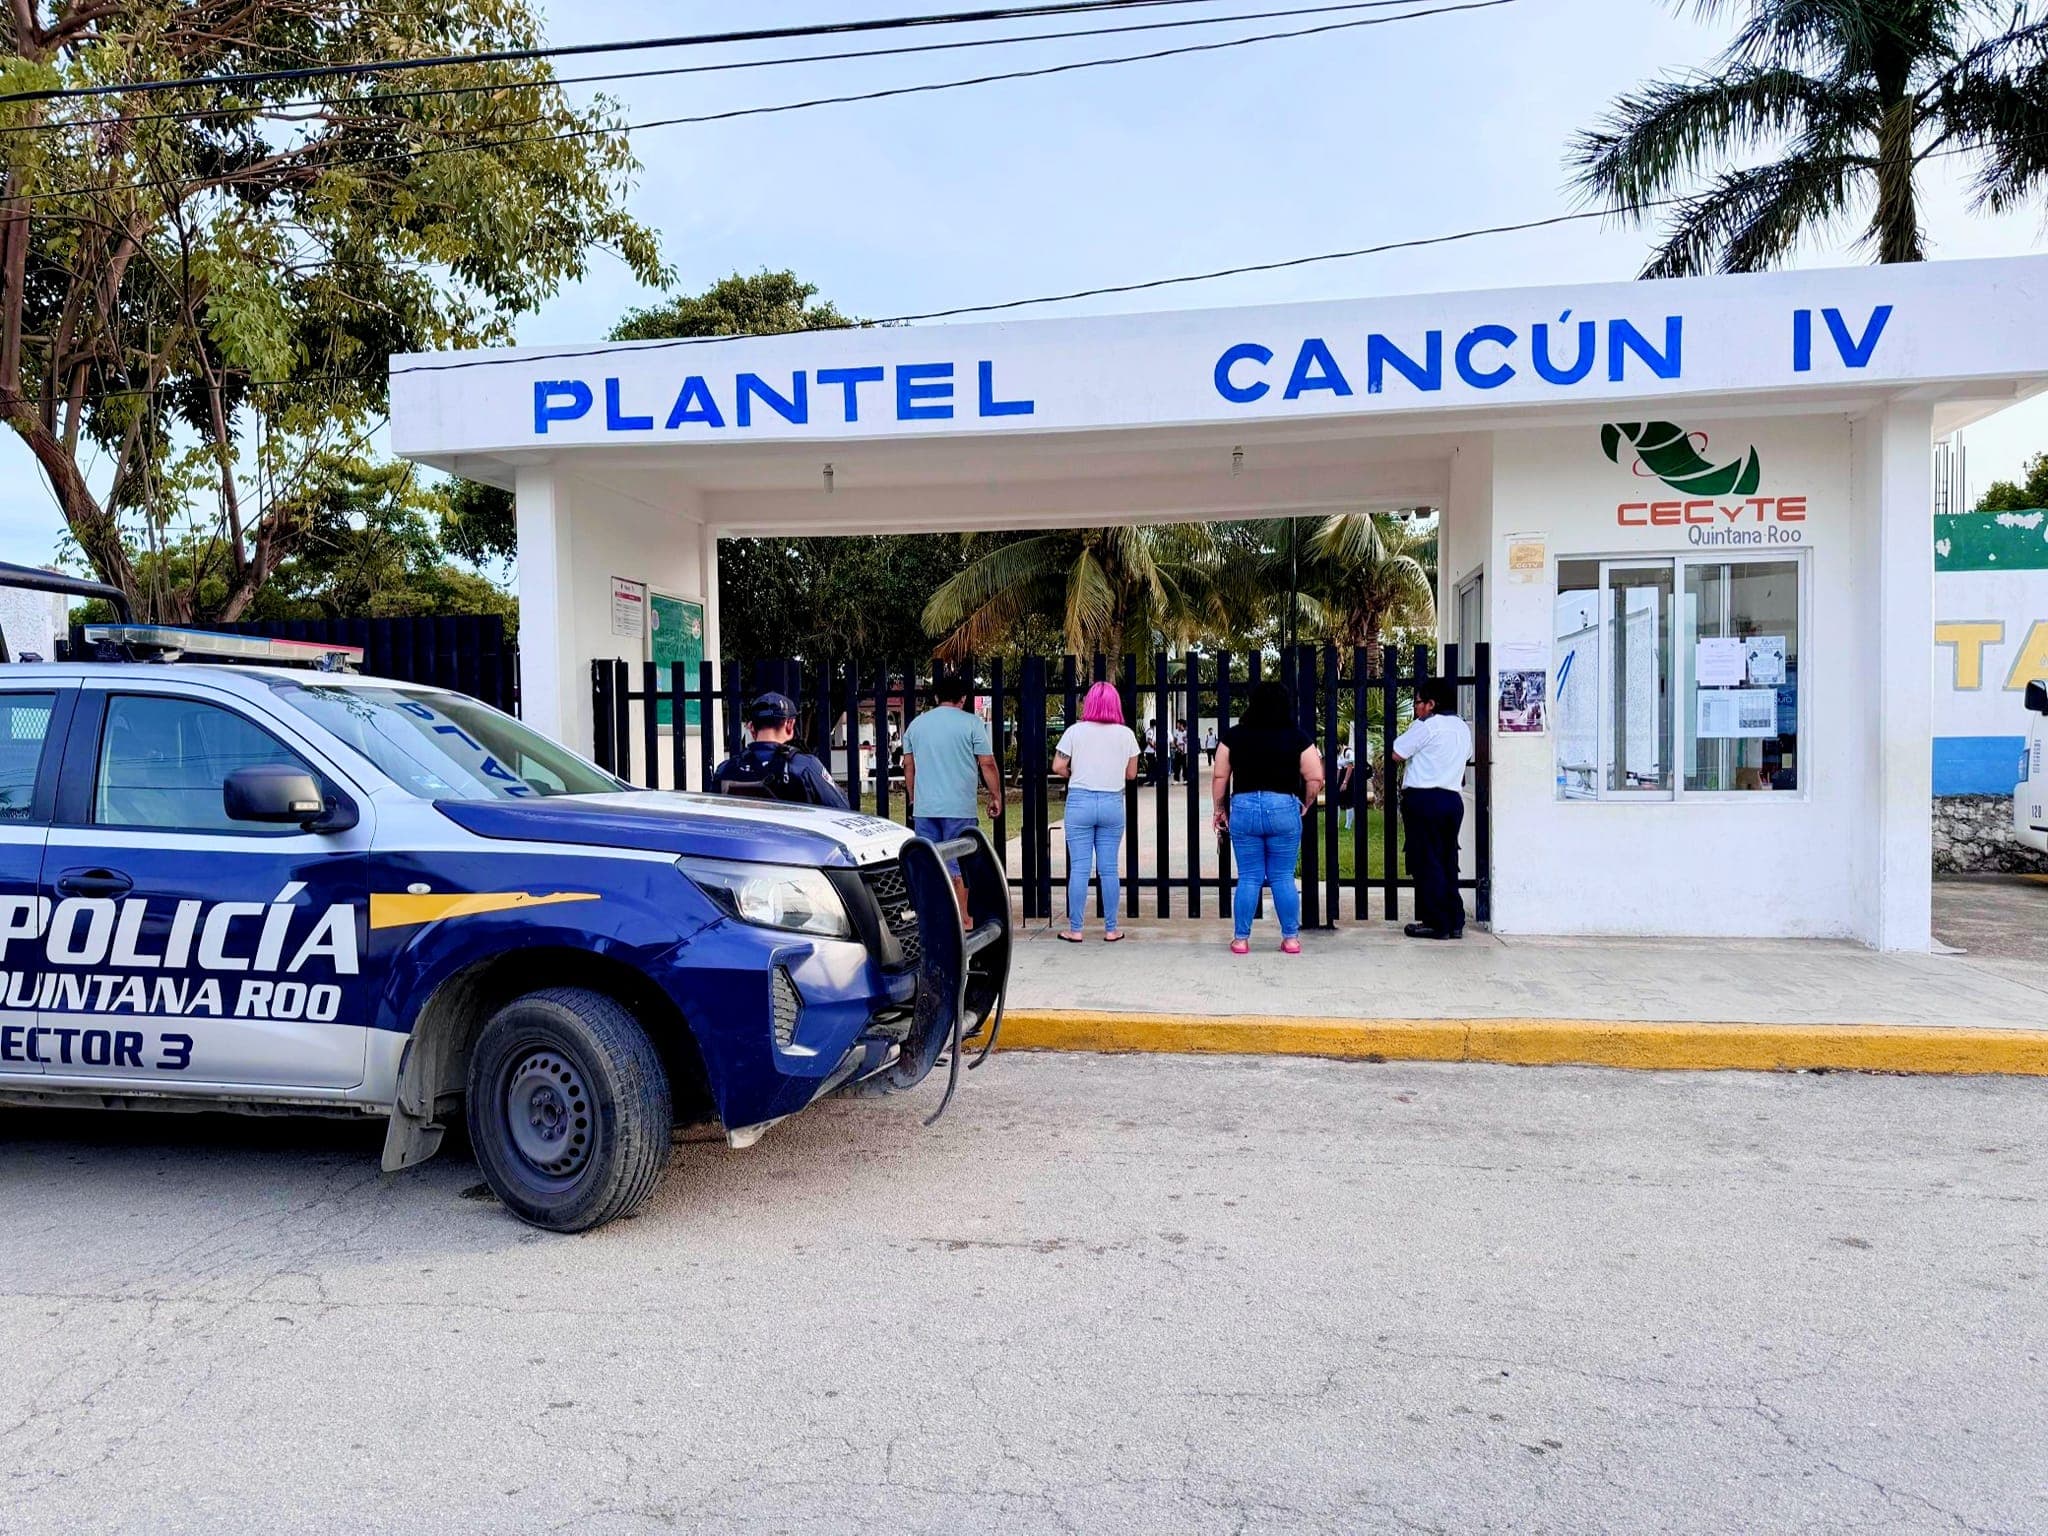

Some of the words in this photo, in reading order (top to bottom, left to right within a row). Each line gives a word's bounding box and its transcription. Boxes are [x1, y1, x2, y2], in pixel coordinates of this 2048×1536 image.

[534, 360, 1034, 434] PLANTEL
[1214, 309, 1683, 403] CANCÚN
[1793, 305, 1893, 372] IV
[1618, 497, 1806, 526] CECYTE
[1688, 525, 1762, 546] Quintana
[1767, 525, 1802, 543] Roo
[0, 882, 359, 975] POLICÍA
[233, 980, 342, 1022] ROO
[156, 1033, 194, 1070] 3
